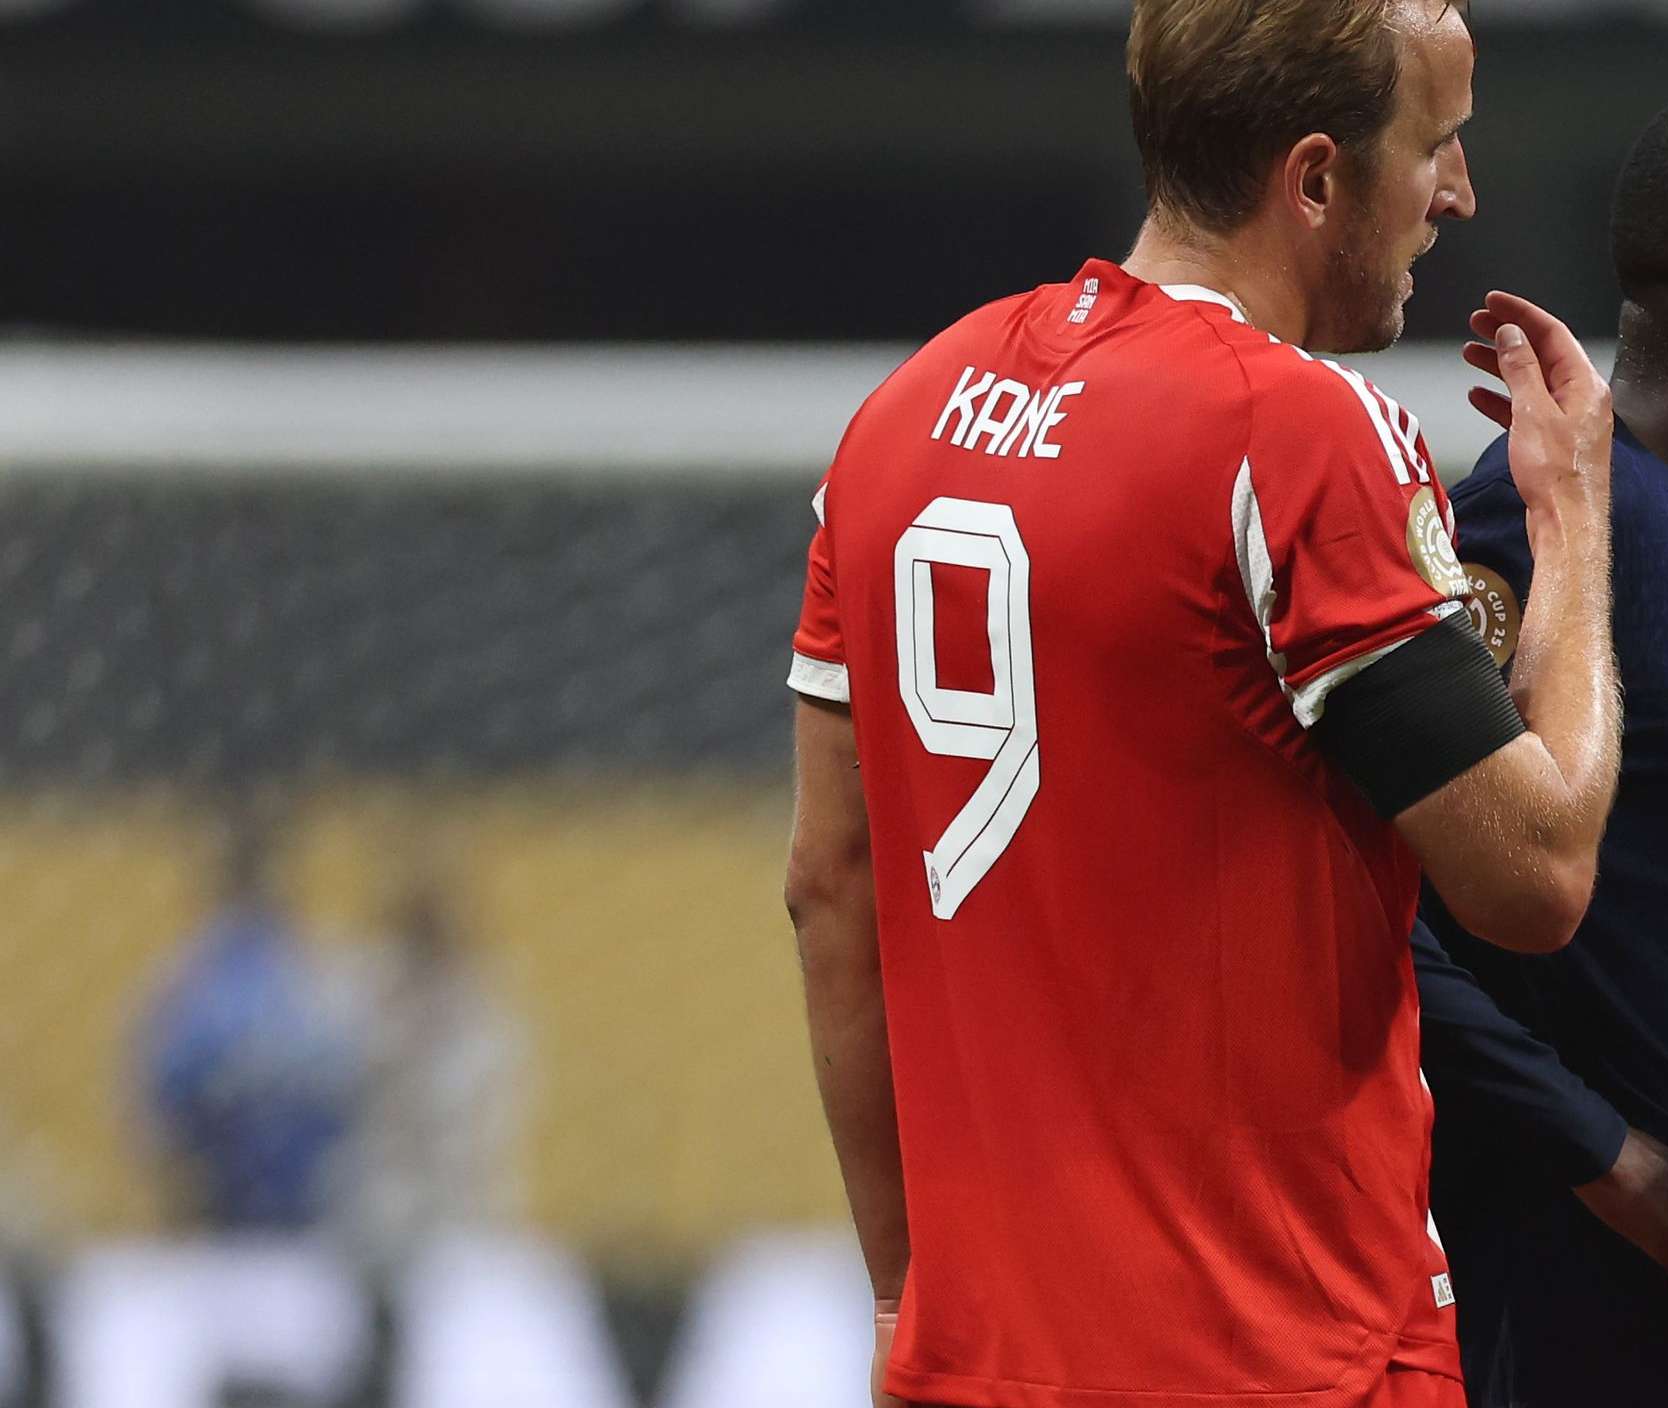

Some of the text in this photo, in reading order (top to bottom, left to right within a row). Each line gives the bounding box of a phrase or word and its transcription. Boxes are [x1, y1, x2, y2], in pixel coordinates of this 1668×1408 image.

[931, 365, 1084, 459] KANE
[1487, 590, 1507, 648] CUP 25
[894, 496, 1040, 921] 9
